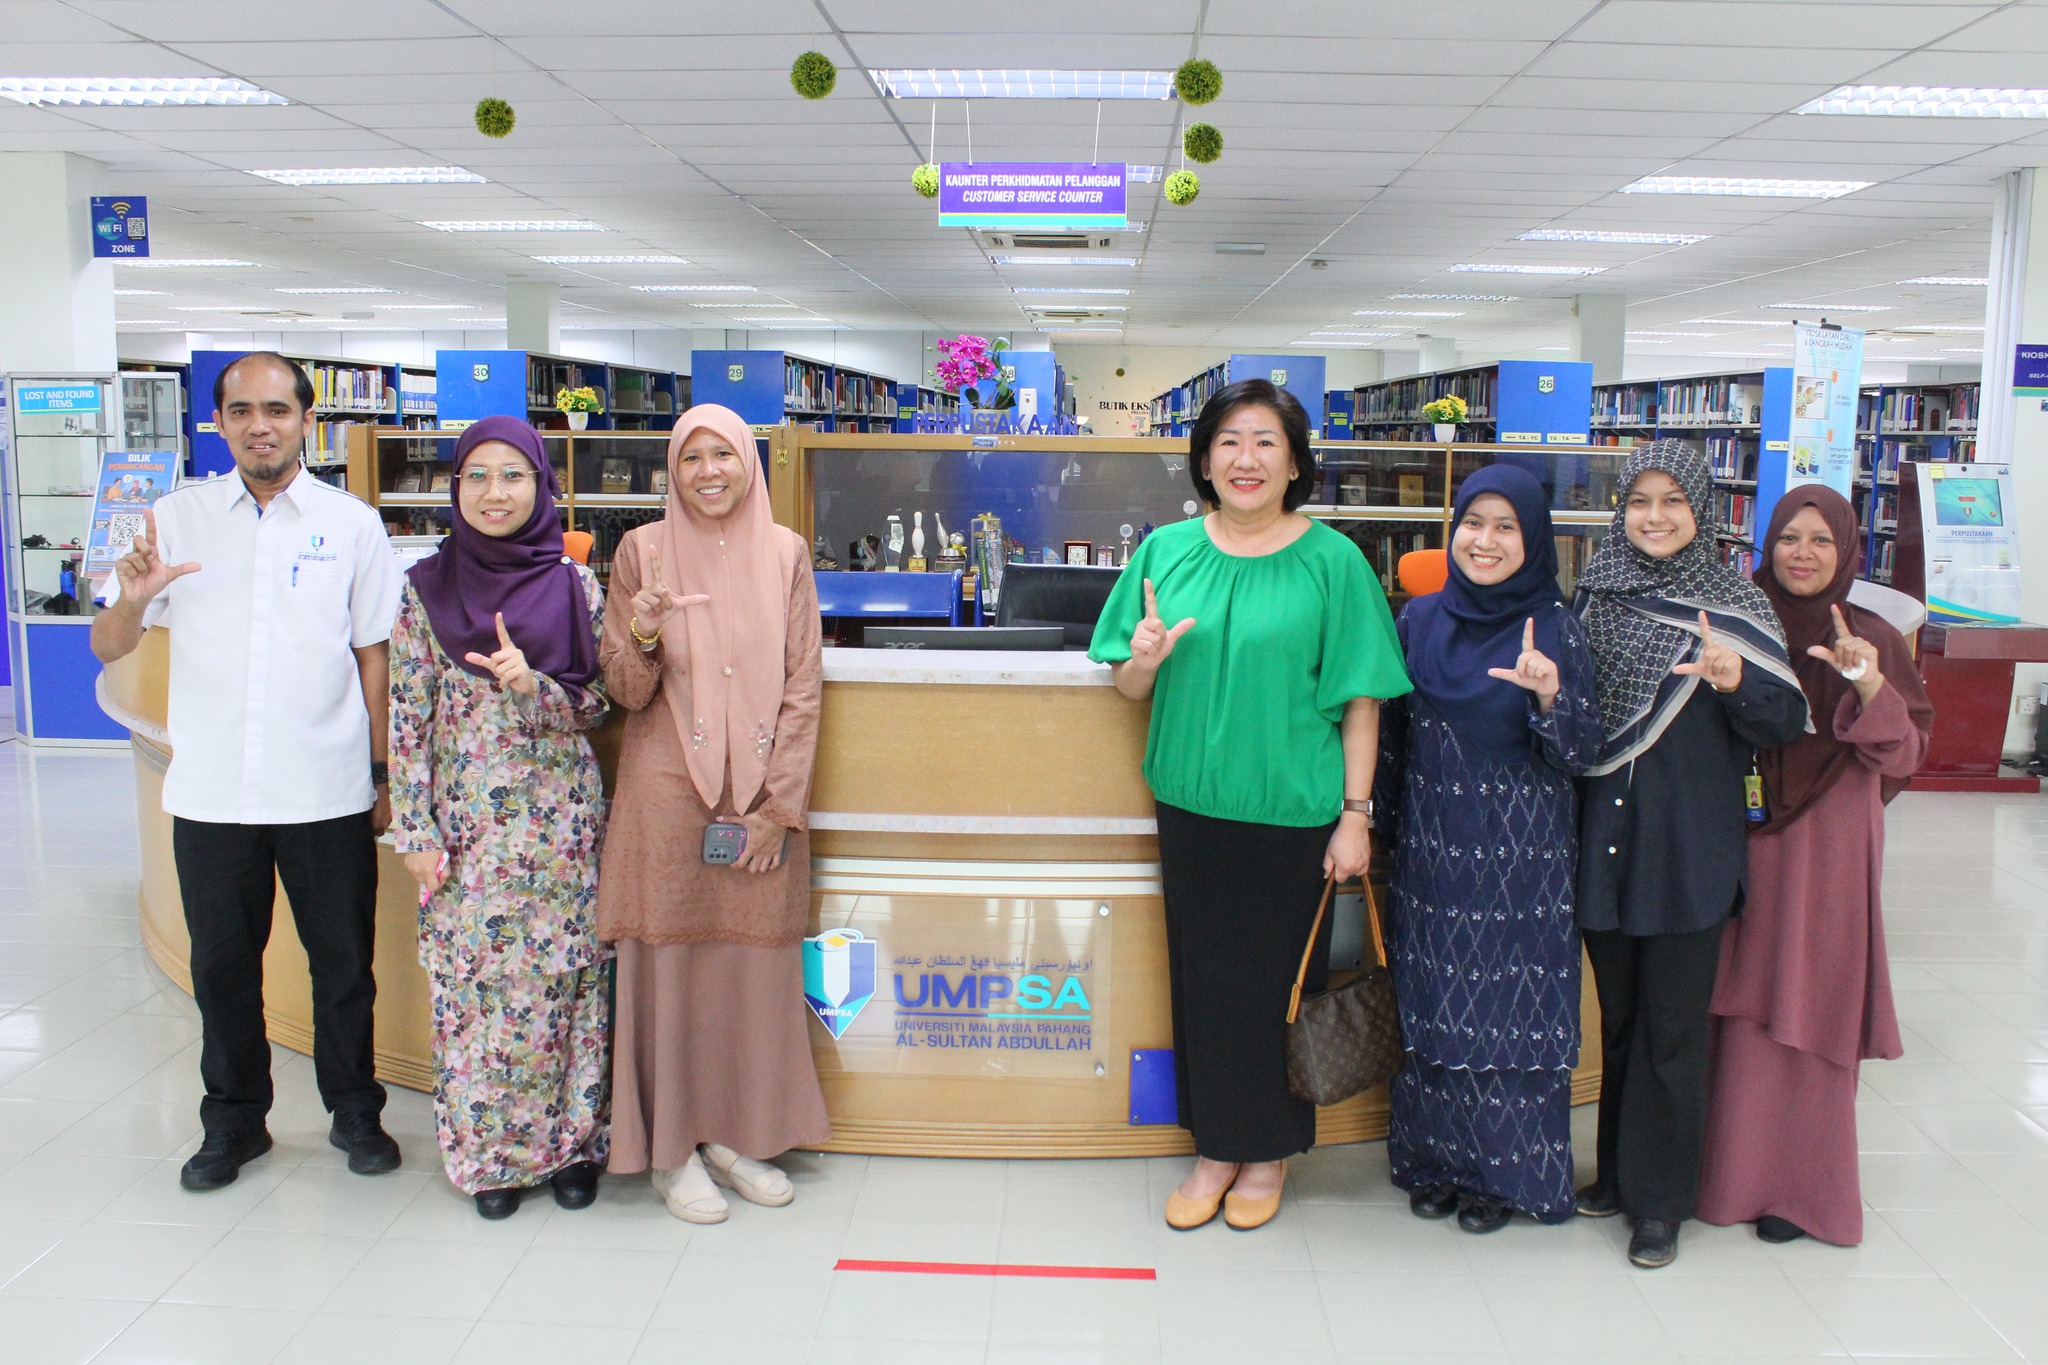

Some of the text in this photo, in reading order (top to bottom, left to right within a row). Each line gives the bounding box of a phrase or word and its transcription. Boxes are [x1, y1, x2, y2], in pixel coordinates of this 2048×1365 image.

[946, 174, 1120, 187] KAUNTER PERKHIDMATAN PELANGGAN
[963, 190, 1102, 203] CUSTOMER SERVICE COUNTER
[474, 368, 488, 376] 30
[729, 368, 742, 377] 29
[1273, 373, 1285, 382] 27
[1540, 380, 1553, 389] 26
[24, 390, 94, 400] LOST AND FOUND
[49, 398, 73, 408] ITEMS
[1100, 401, 1128, 410] BUTIK
[912, 413, 1078, 435] PERPUSTAKAAN
[128, 454, 151, 462] BILIK
[894, 973, 1091, 1010] UMPSA
[819, 1008, 853, 1017] UMPSA
[895, 1021, 1091, 1035] UNIVERSITI MALAYSIA PAHANG
[896, 1034, 1091, 1050] AL-SULTAN ABDULLAH
